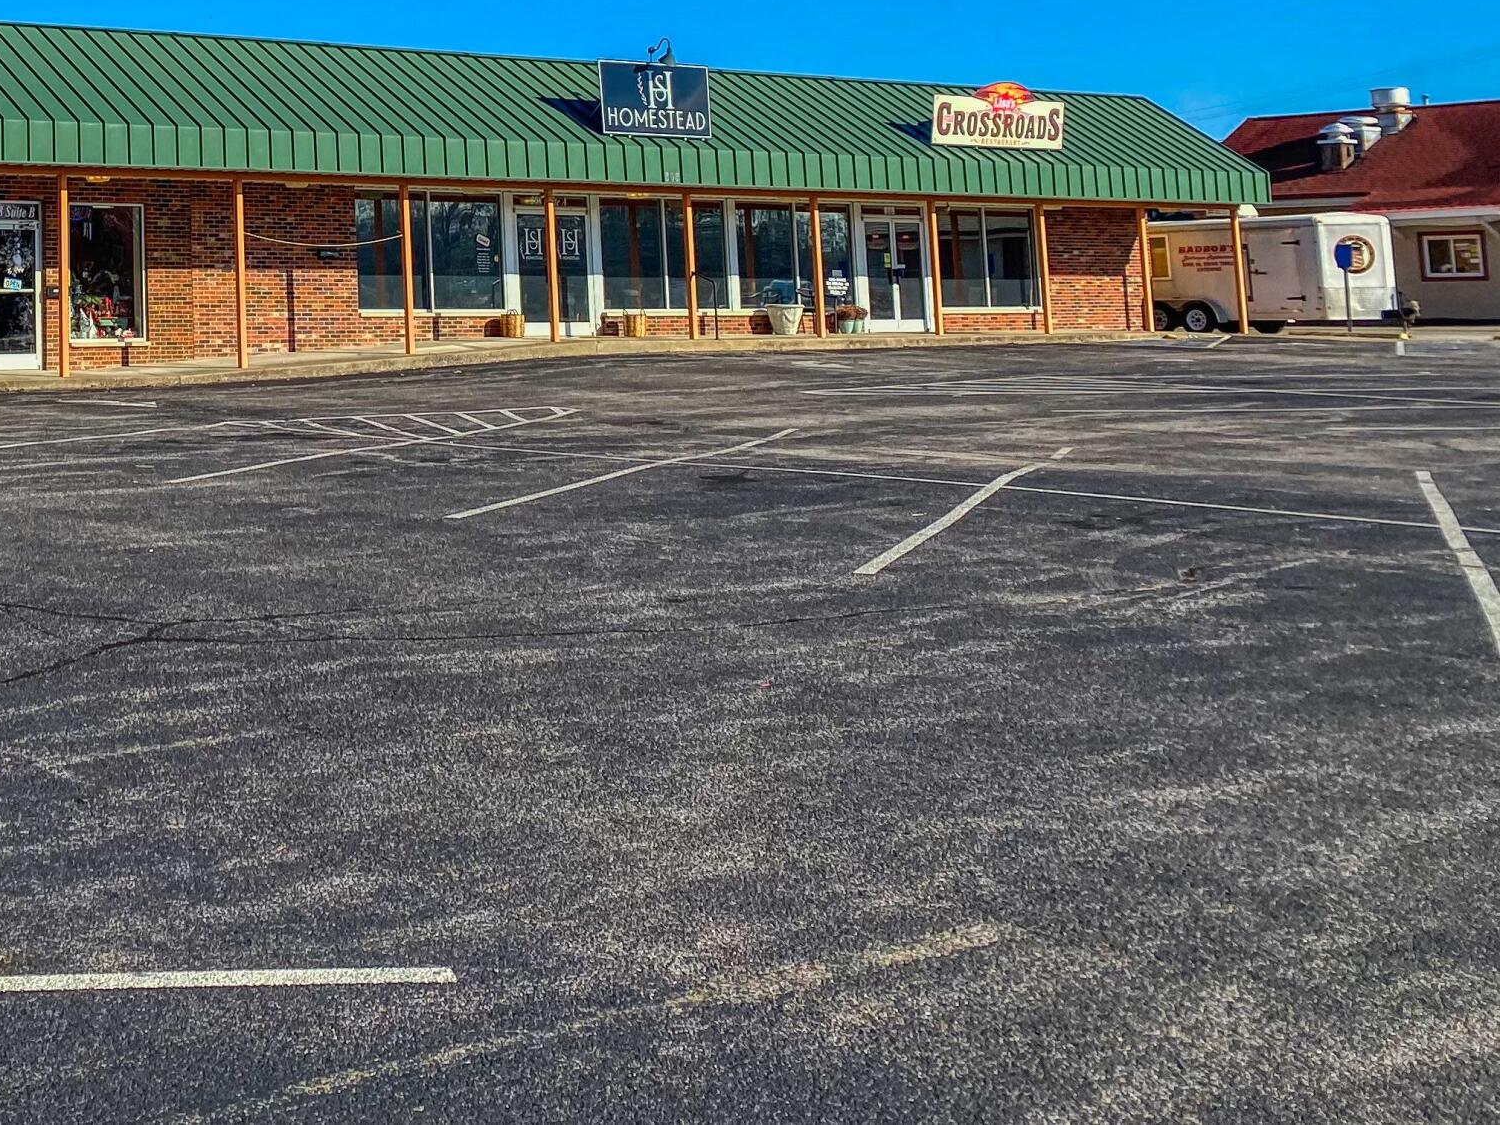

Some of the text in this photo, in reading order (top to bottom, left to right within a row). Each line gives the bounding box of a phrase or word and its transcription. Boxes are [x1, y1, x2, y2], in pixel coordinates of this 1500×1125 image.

[607, 106, 706, 131] HOMESTEAD
[936, 101, 1060, 141] CROSSROADS
[5, 205, 27, 219] Suite
[28, 206, 35, 218] B
